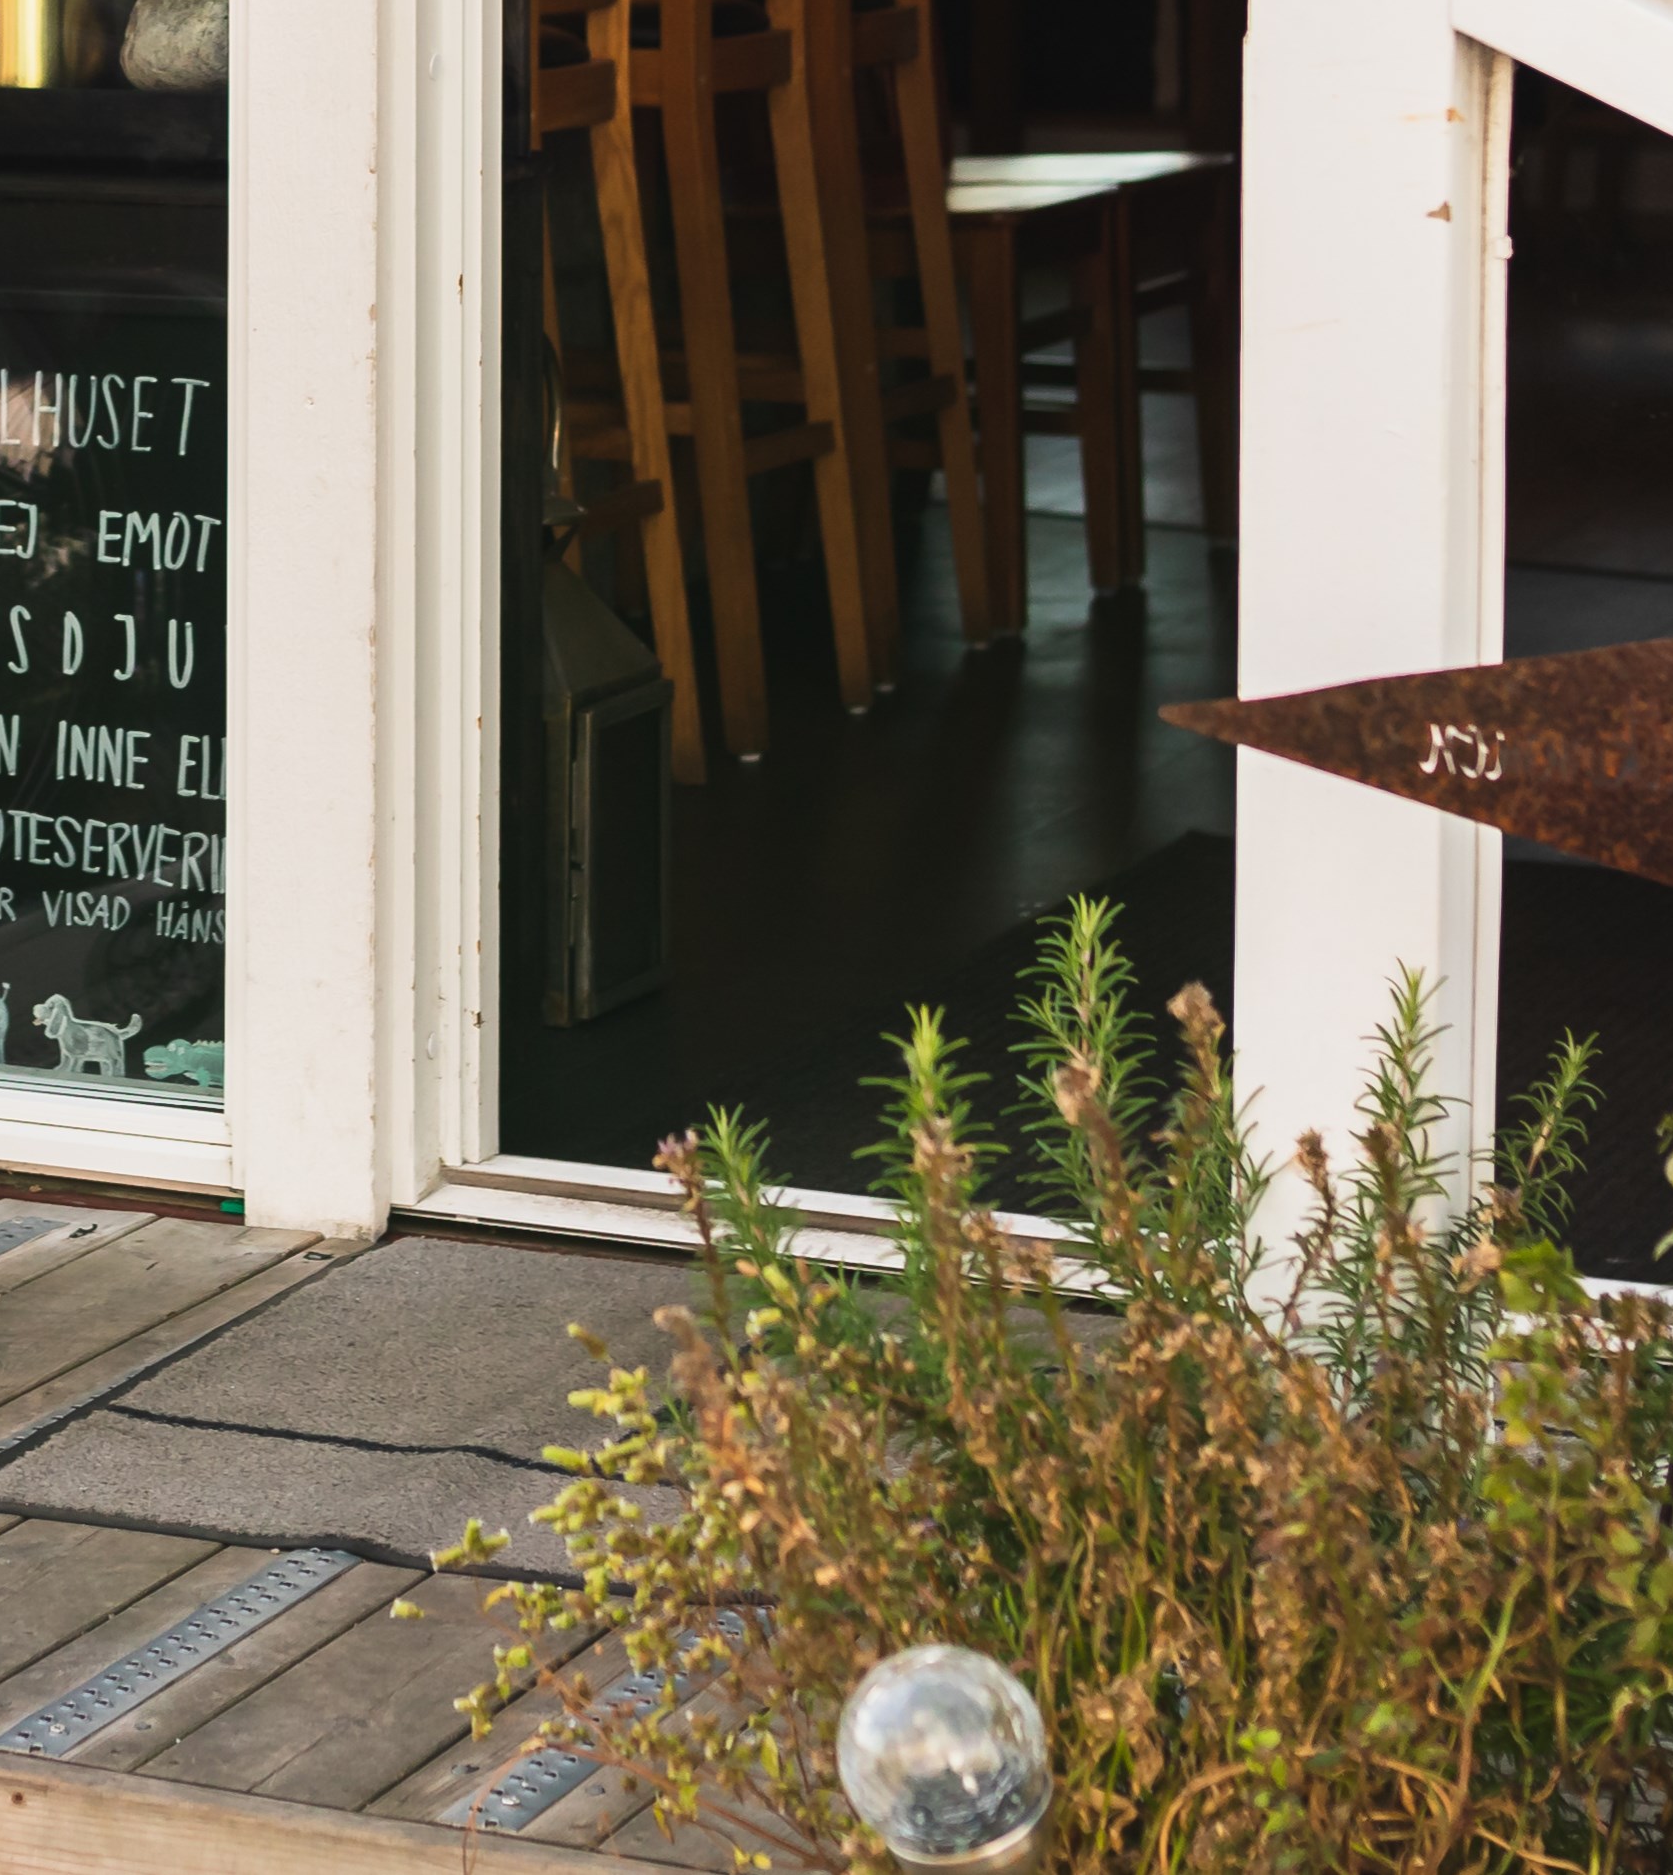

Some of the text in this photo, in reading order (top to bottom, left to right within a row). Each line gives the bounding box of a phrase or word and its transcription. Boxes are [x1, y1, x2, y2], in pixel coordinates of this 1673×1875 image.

[95, 508, 223, 573] EMOT
[56, 719, 151, 790] INNE
[42, 889, 131, 932] VISAD
